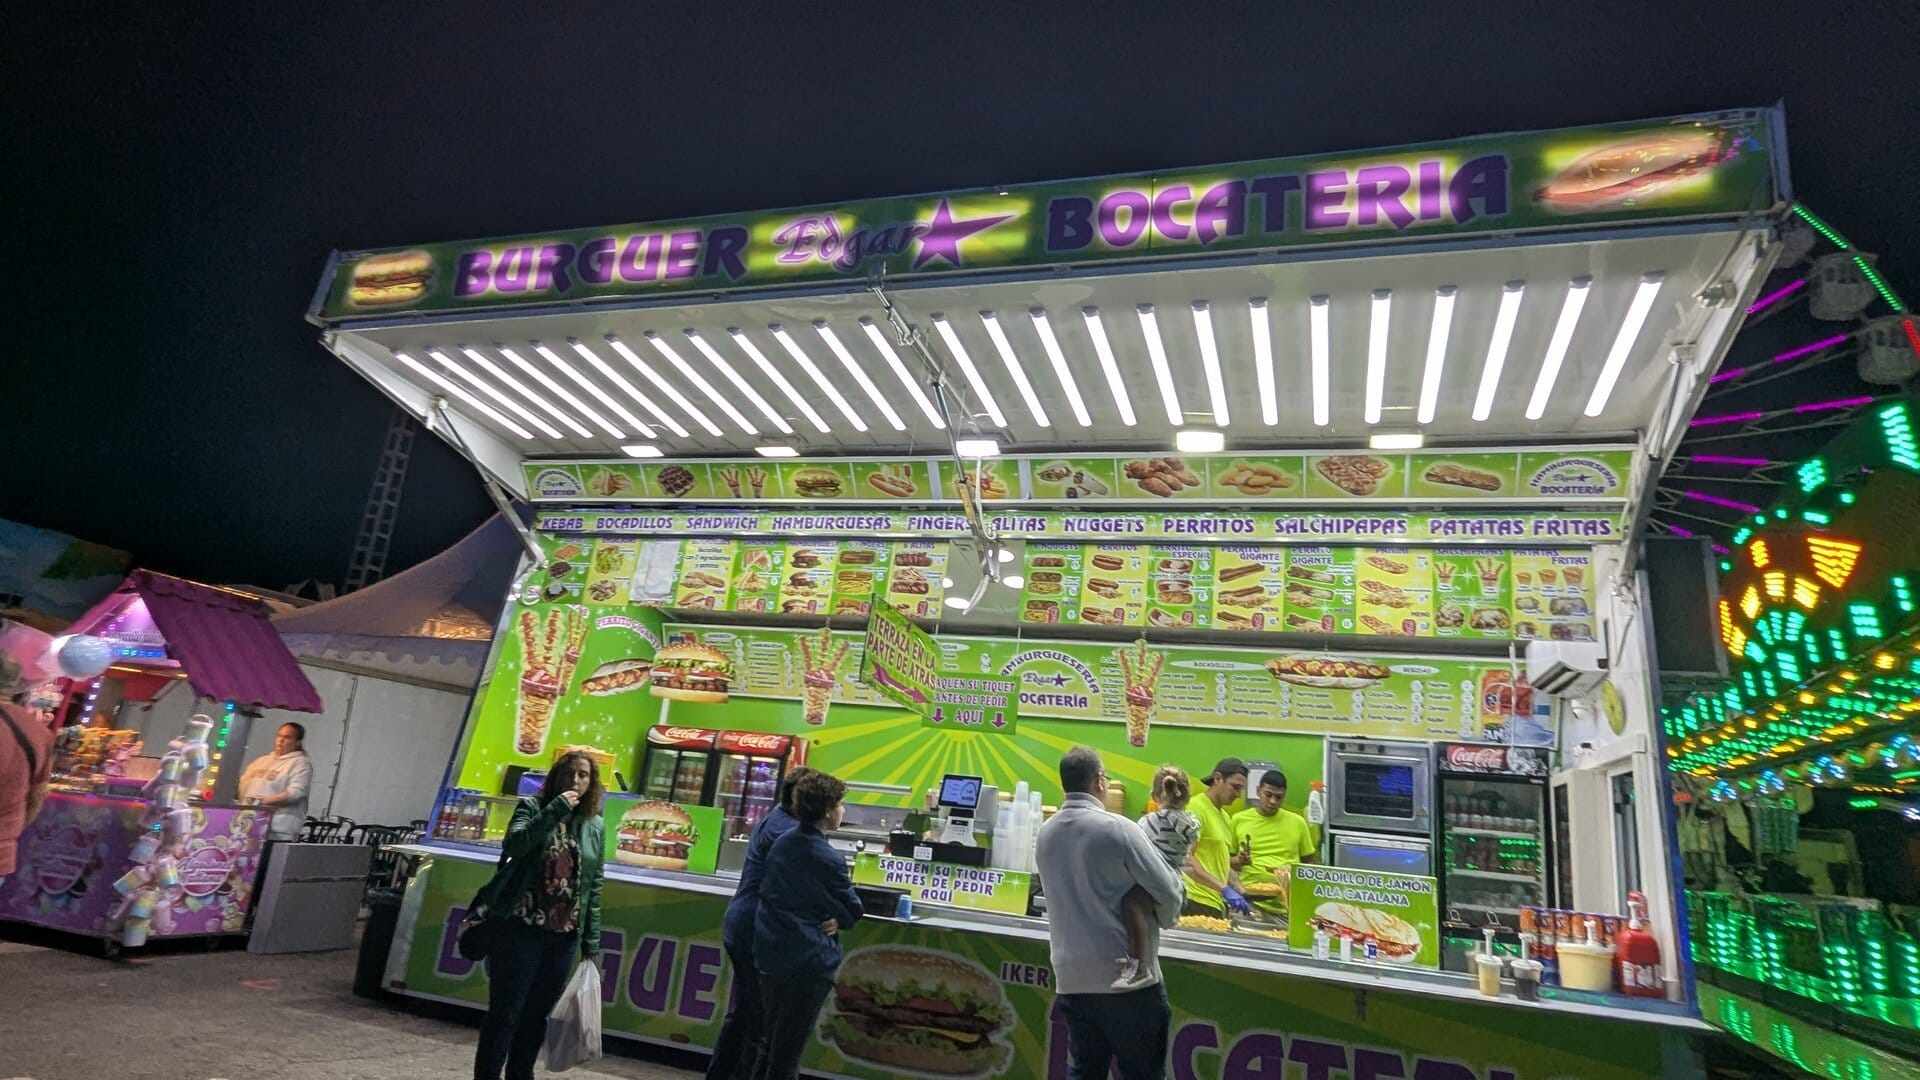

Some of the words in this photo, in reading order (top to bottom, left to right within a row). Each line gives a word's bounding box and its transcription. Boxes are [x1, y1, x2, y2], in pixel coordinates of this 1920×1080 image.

[454, 226, 749, 297] BURGUER
[773, 213, 931, 271] Edgar
[1047, 154, 1509, 251] BOCATERIA
[542, 517, 583, 529] KEBAB
[596, 517, 673, 529] BOCADILLOS
[686, 517, 758, 530] SANDWICH
[772, 516, 891, 530] HAMBURGUESAS
[991, 517, 1046, 532] ALITAS
[1064, 518, 1145, 533] NUGGETS
[1163, 518, 1255, 534] PERRITOS
[1275, 518, 1407, 535] SALCHIPAPAS
[1430, 519, 1524, 536] PATATAS
[1533, 519, 1611, 536] FRITAS
[874, 614, 910, 653] TERRAZA
[912, 643, 924, 662] EN
[867, 632, 895, 666] PARTE
[896, 653, 908, 674] DE
[983, 681, 1016, 692] TIQUET
[936, 693, 964, 704] ANTES
[980, 696, 1008, 707] PEDIR
[1019, 692, 1088, 709] OCATERÍA
[879, 859, 929, 875] SAQUEN
[935, 865, 950, 877] SU
[956, 867, 1004, 884] TIQUET
[1297, 867, 1365, 886] BOCADILLO
[1367, 876, 1384, 888] DE
[886, 872, 926, 886] ANTES
[932, 878, 947, 889] DE
[954, 881, 993, 896] PEDIR
[1314, 885, 1324, 897] A
[1325, 887, 1341, 899] LA
[1342, 890, 1409, 907] CATALANA
[1001, 962, 1049, 988] IKER
